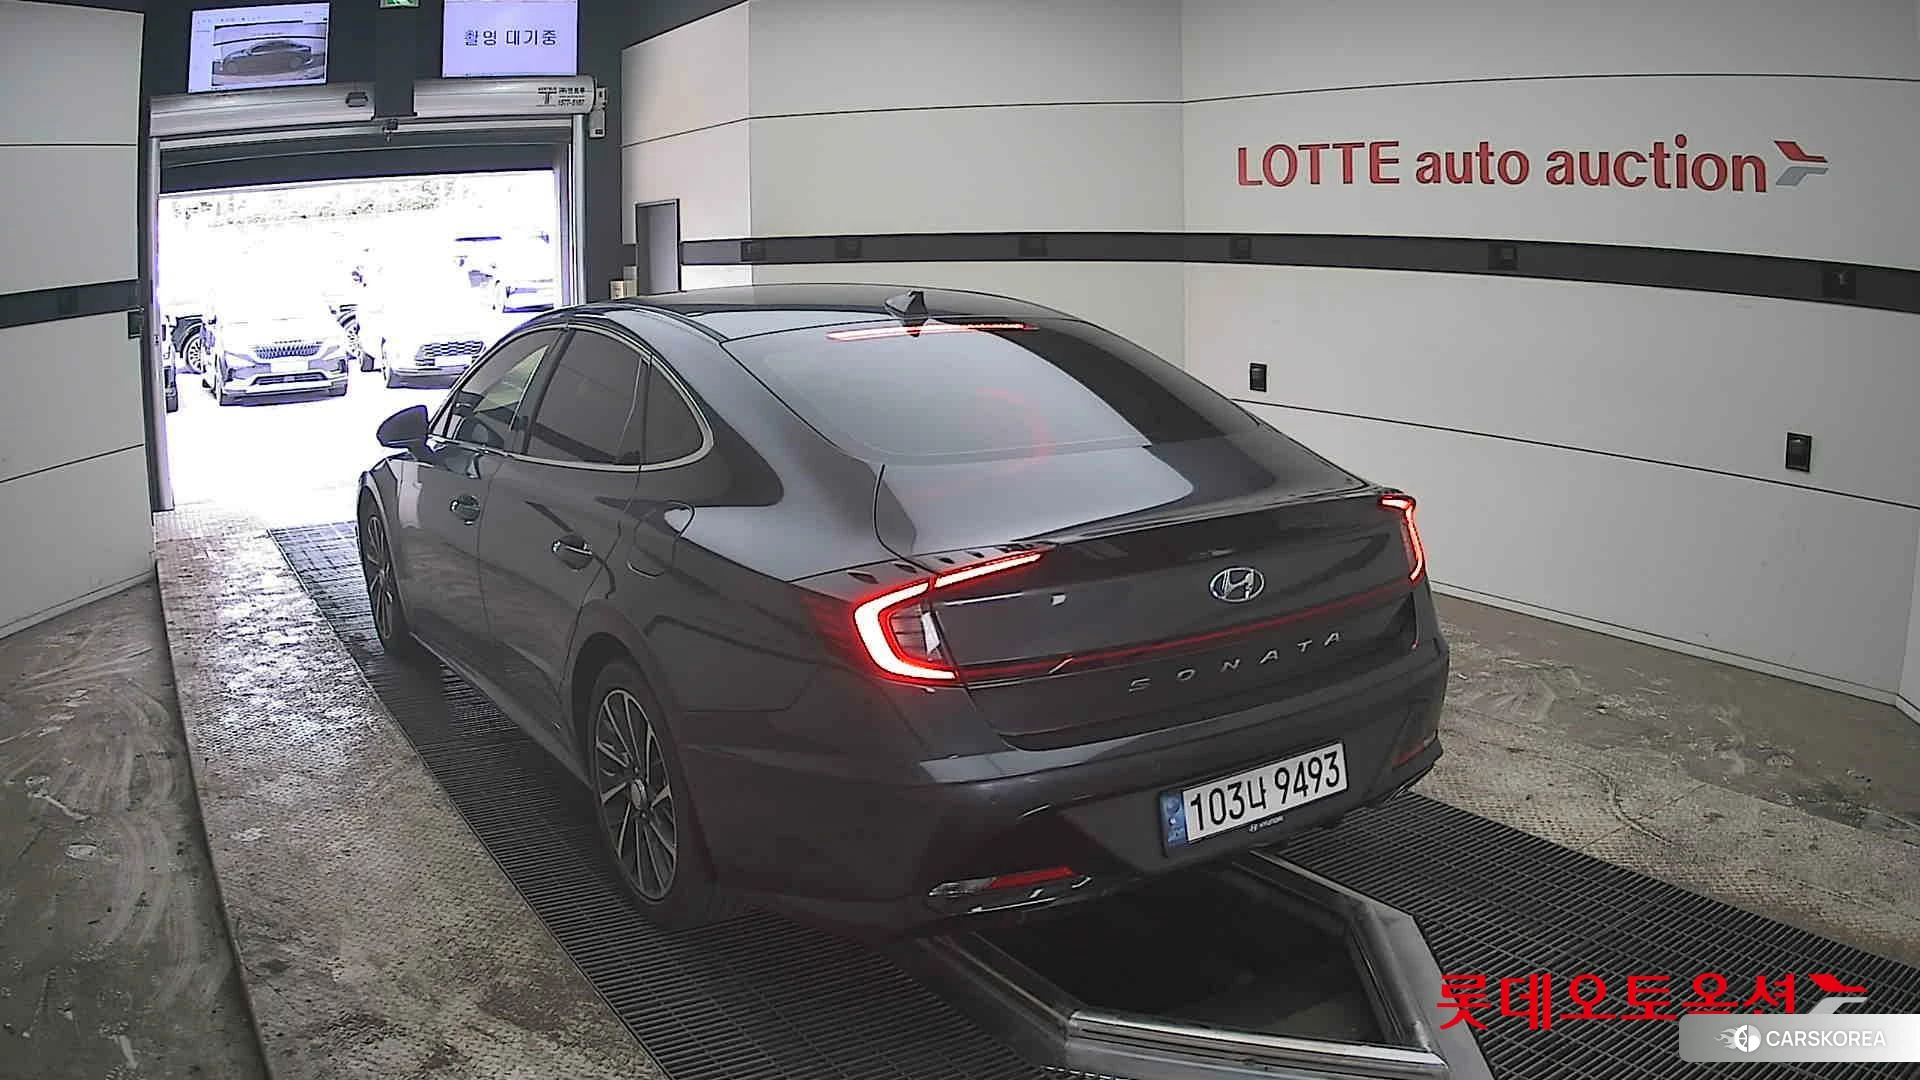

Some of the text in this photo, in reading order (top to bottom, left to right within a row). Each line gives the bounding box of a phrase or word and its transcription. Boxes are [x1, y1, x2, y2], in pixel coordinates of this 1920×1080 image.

[506, 29, 557, 46] 대기중
[1237, 134, 1767, 192] LOTTE auto auction
[1128, 631, 1343, 693] SONATA
[1190, 751, 1340, 831] 103나 9493
